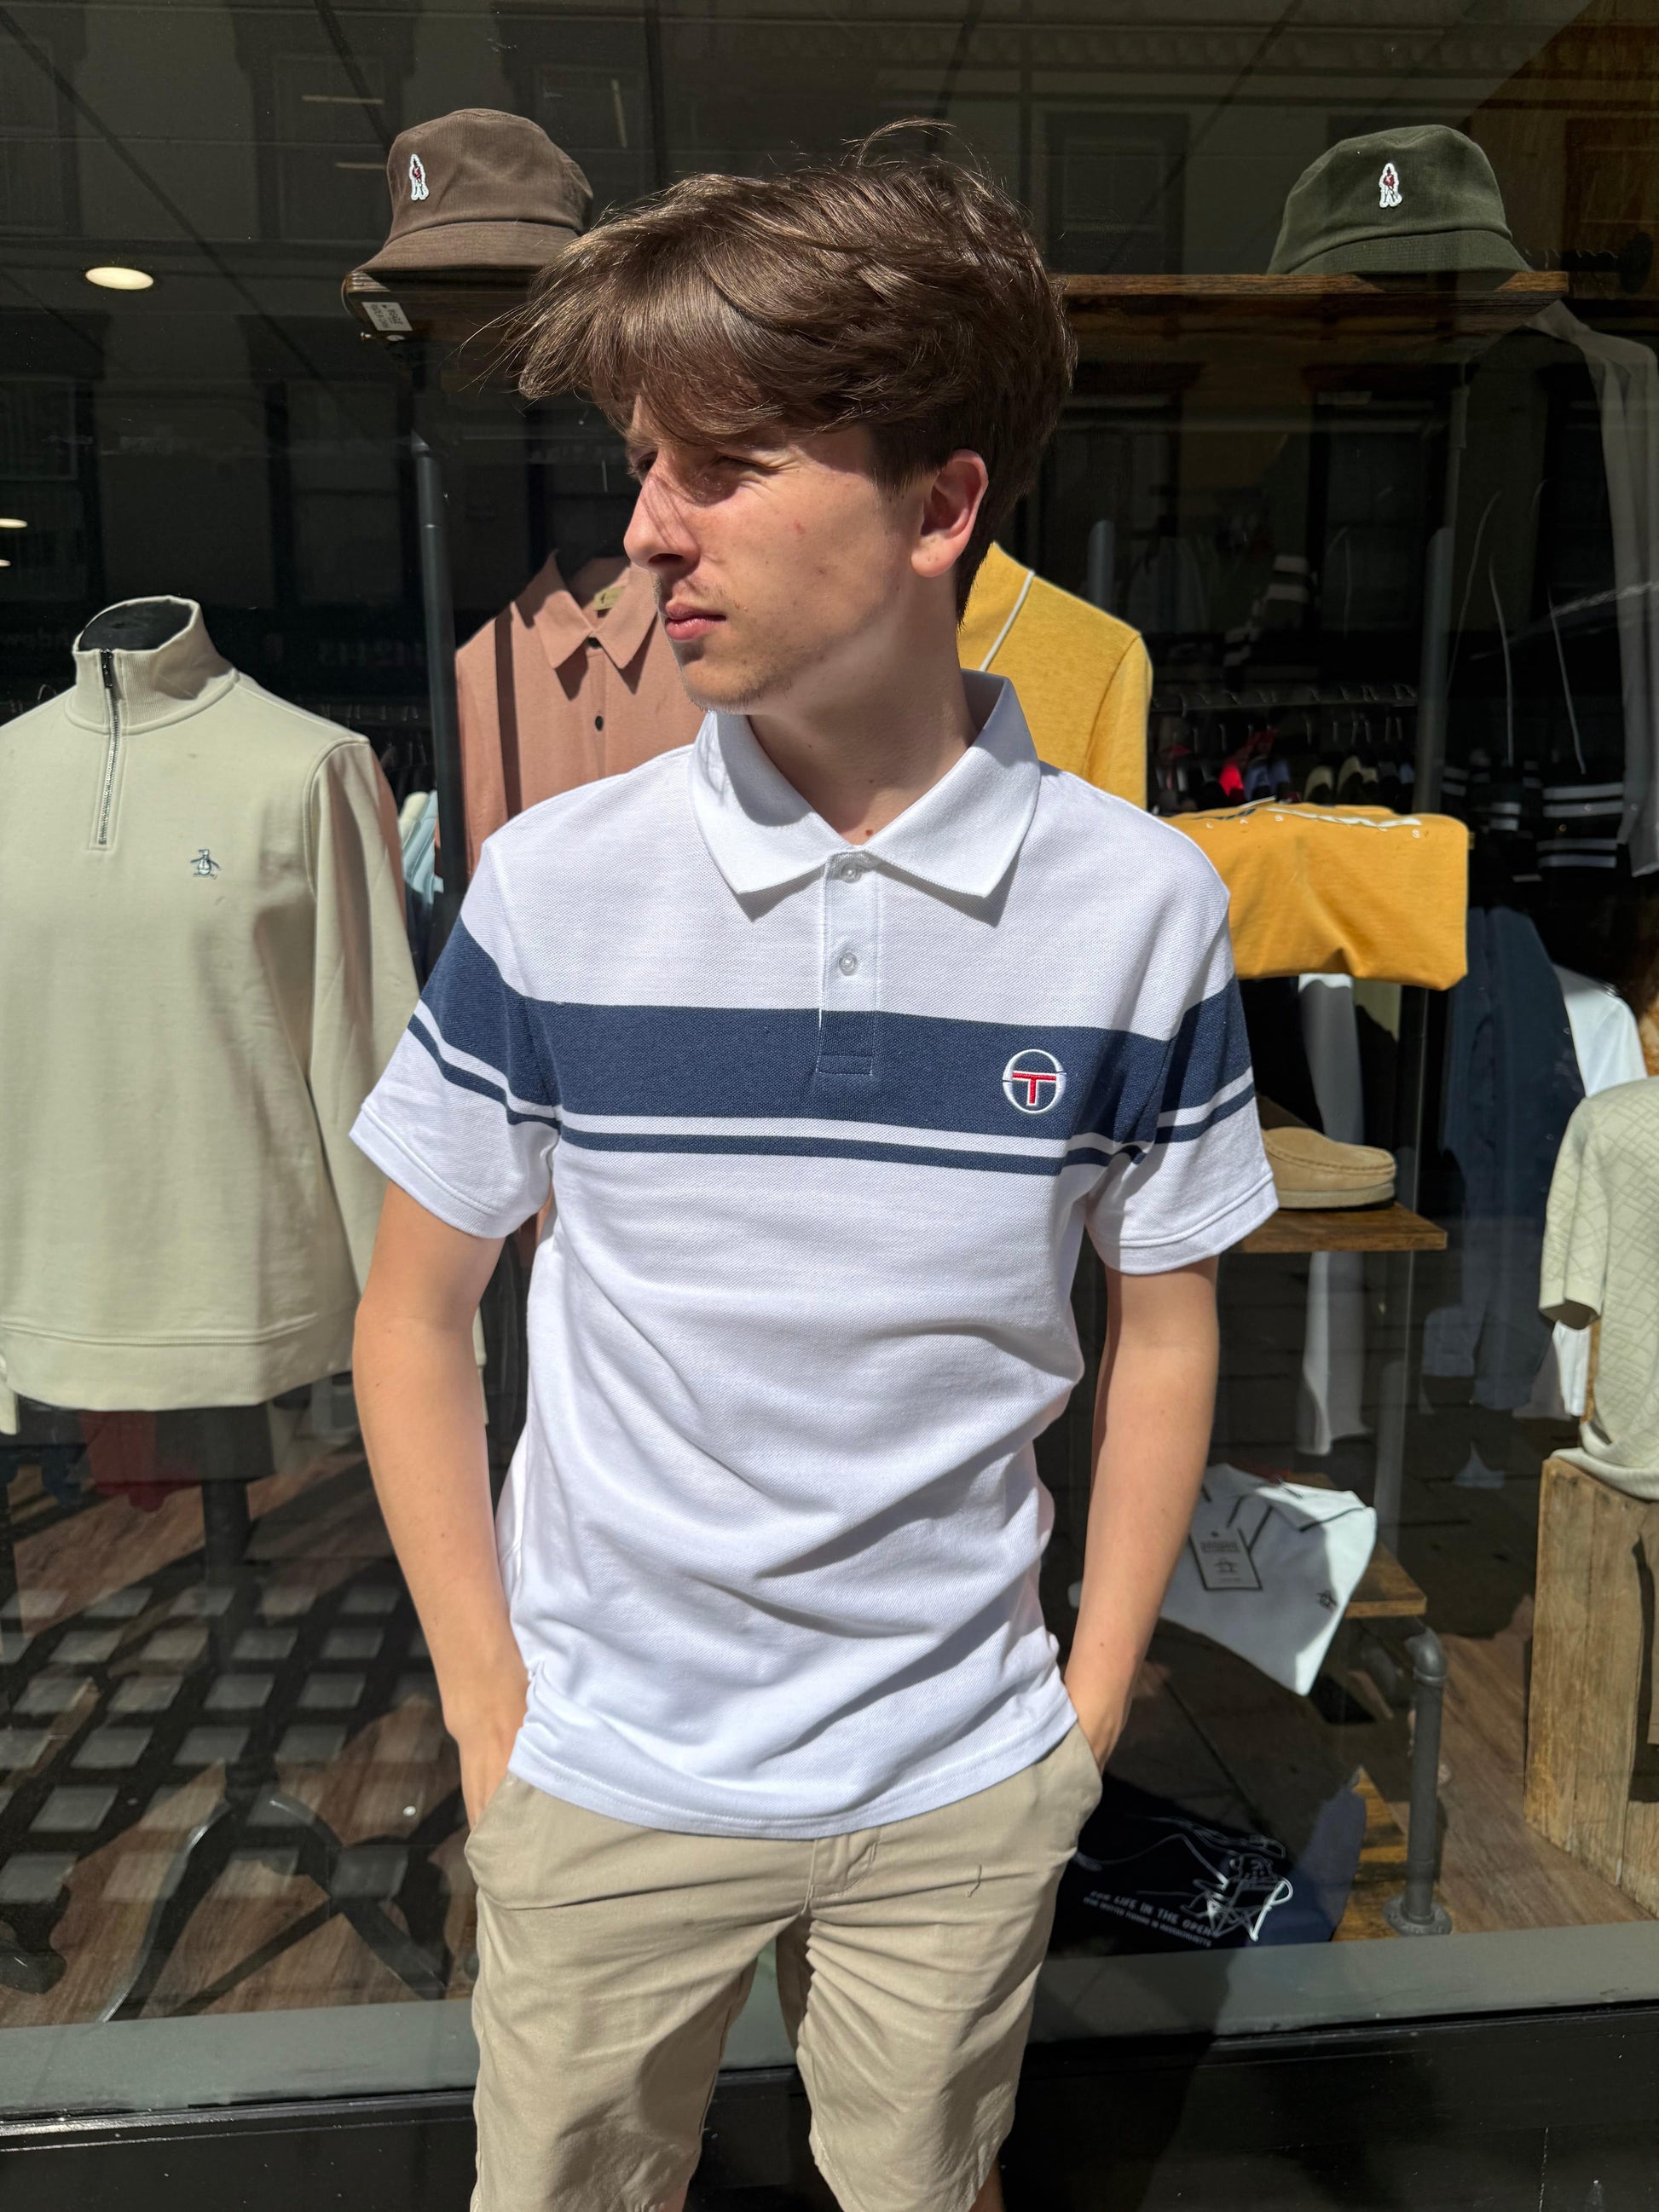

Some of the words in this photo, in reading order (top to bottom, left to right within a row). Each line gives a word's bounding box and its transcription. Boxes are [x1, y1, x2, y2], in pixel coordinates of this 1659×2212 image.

[1113, 1896, 1137, 1909] LIFE
[1140, 1902, 1153, 1915] IN
[1158, 1909, 1179, 1924] THE
